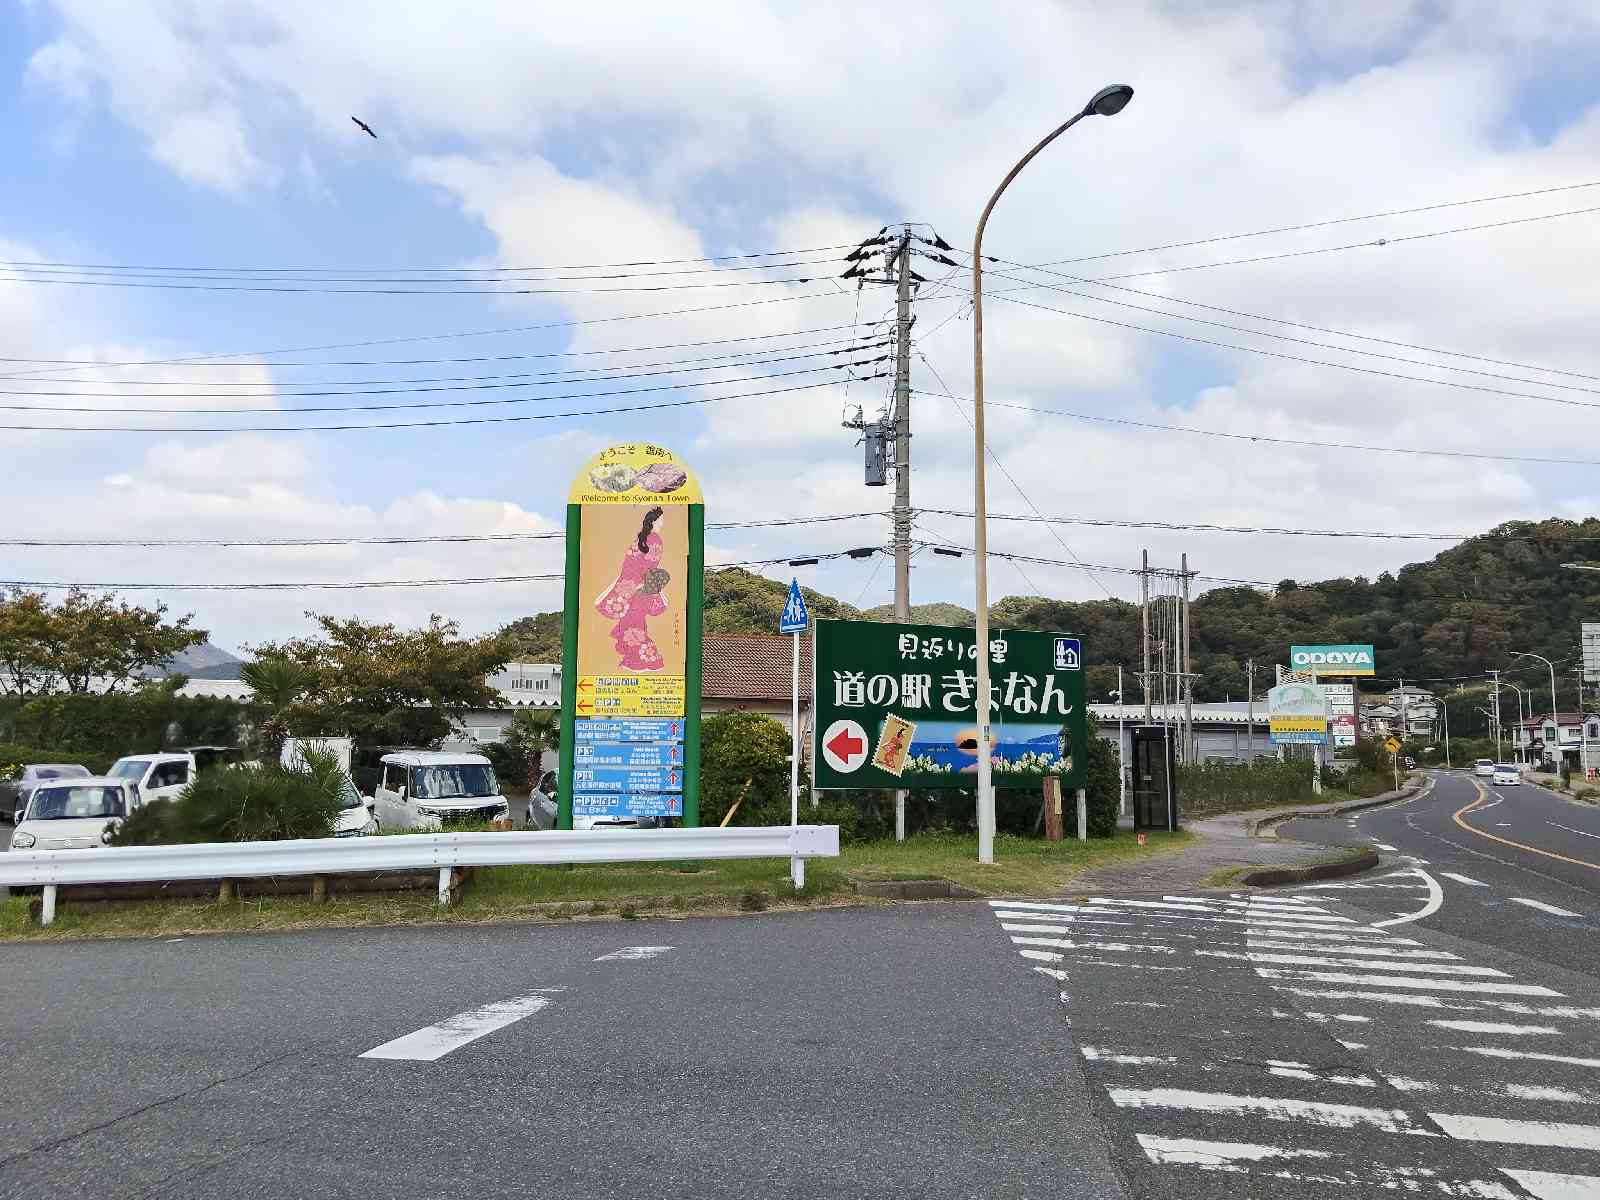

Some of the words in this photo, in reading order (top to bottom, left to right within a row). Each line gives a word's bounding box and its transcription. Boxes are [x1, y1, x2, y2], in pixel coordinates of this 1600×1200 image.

[1293, 652, 1371, 665] ODOYA
[833, 670, 932, 709] 道の駅
